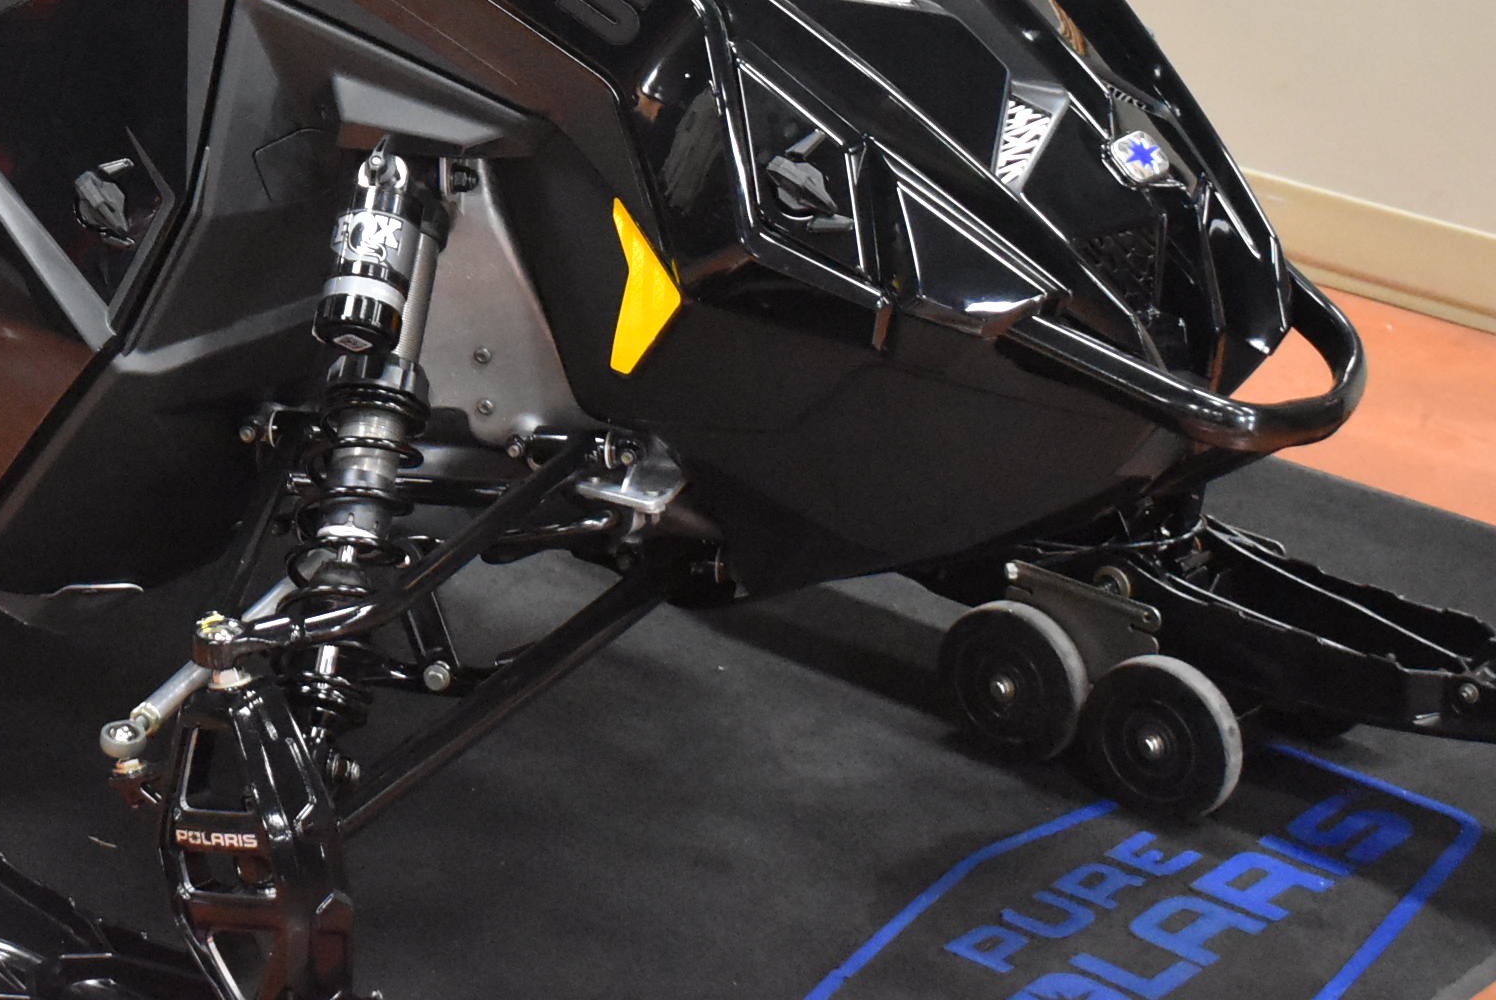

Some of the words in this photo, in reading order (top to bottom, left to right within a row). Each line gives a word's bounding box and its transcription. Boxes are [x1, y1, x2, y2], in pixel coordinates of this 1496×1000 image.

[333, 211, 403, 263] FOX
[175, 828, 259, 849] POLARIS
[943, 830, 1204, 974] PURE
